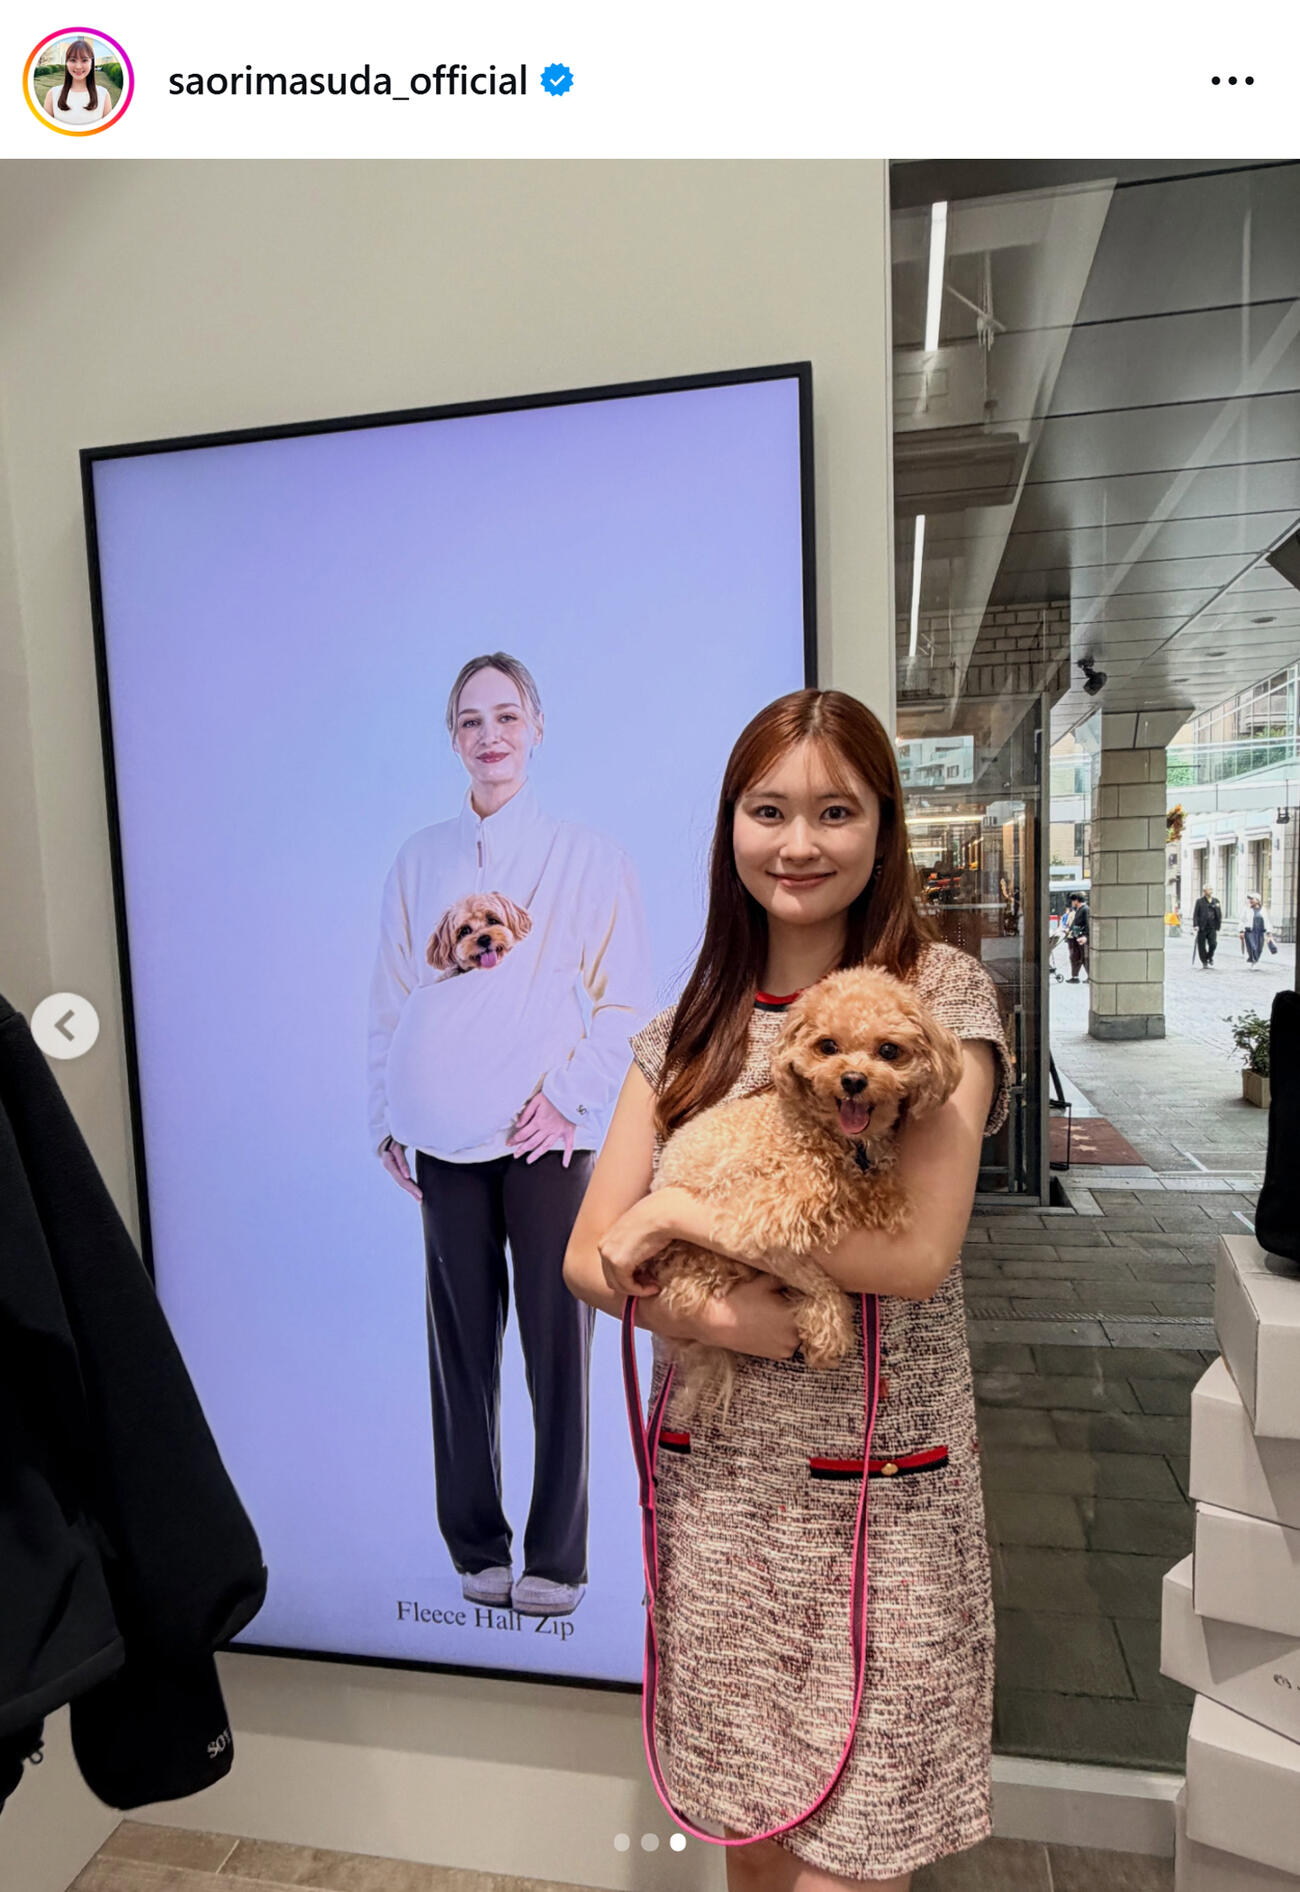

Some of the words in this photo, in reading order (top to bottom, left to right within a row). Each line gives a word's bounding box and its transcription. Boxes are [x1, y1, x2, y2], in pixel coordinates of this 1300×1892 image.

[397, 1600, 466, 1626] Fleece
[474, 1607, 522, 1631] Half
[534, 1615, 575, 1641] Zip
